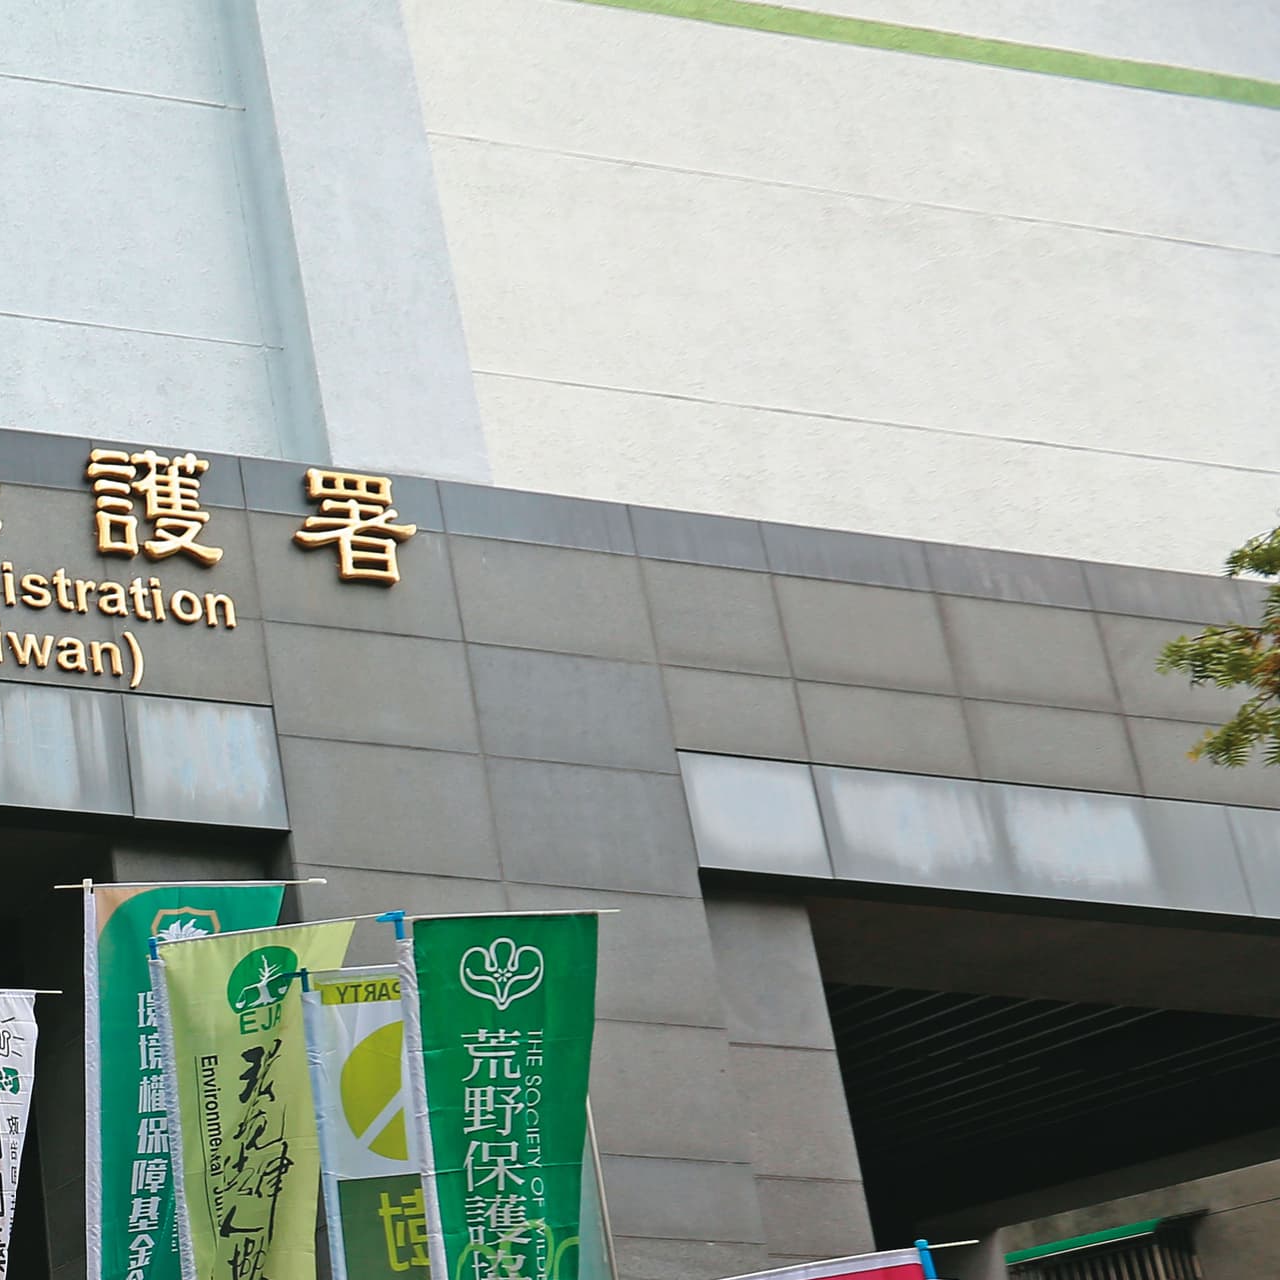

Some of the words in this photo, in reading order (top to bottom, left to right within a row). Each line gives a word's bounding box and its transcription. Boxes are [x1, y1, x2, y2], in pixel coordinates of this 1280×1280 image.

[526, 1029, 544, 1066] THE
[525, 1075, 544, 1167] SOCIETY
[530, 1176, 545, 1208] OF
